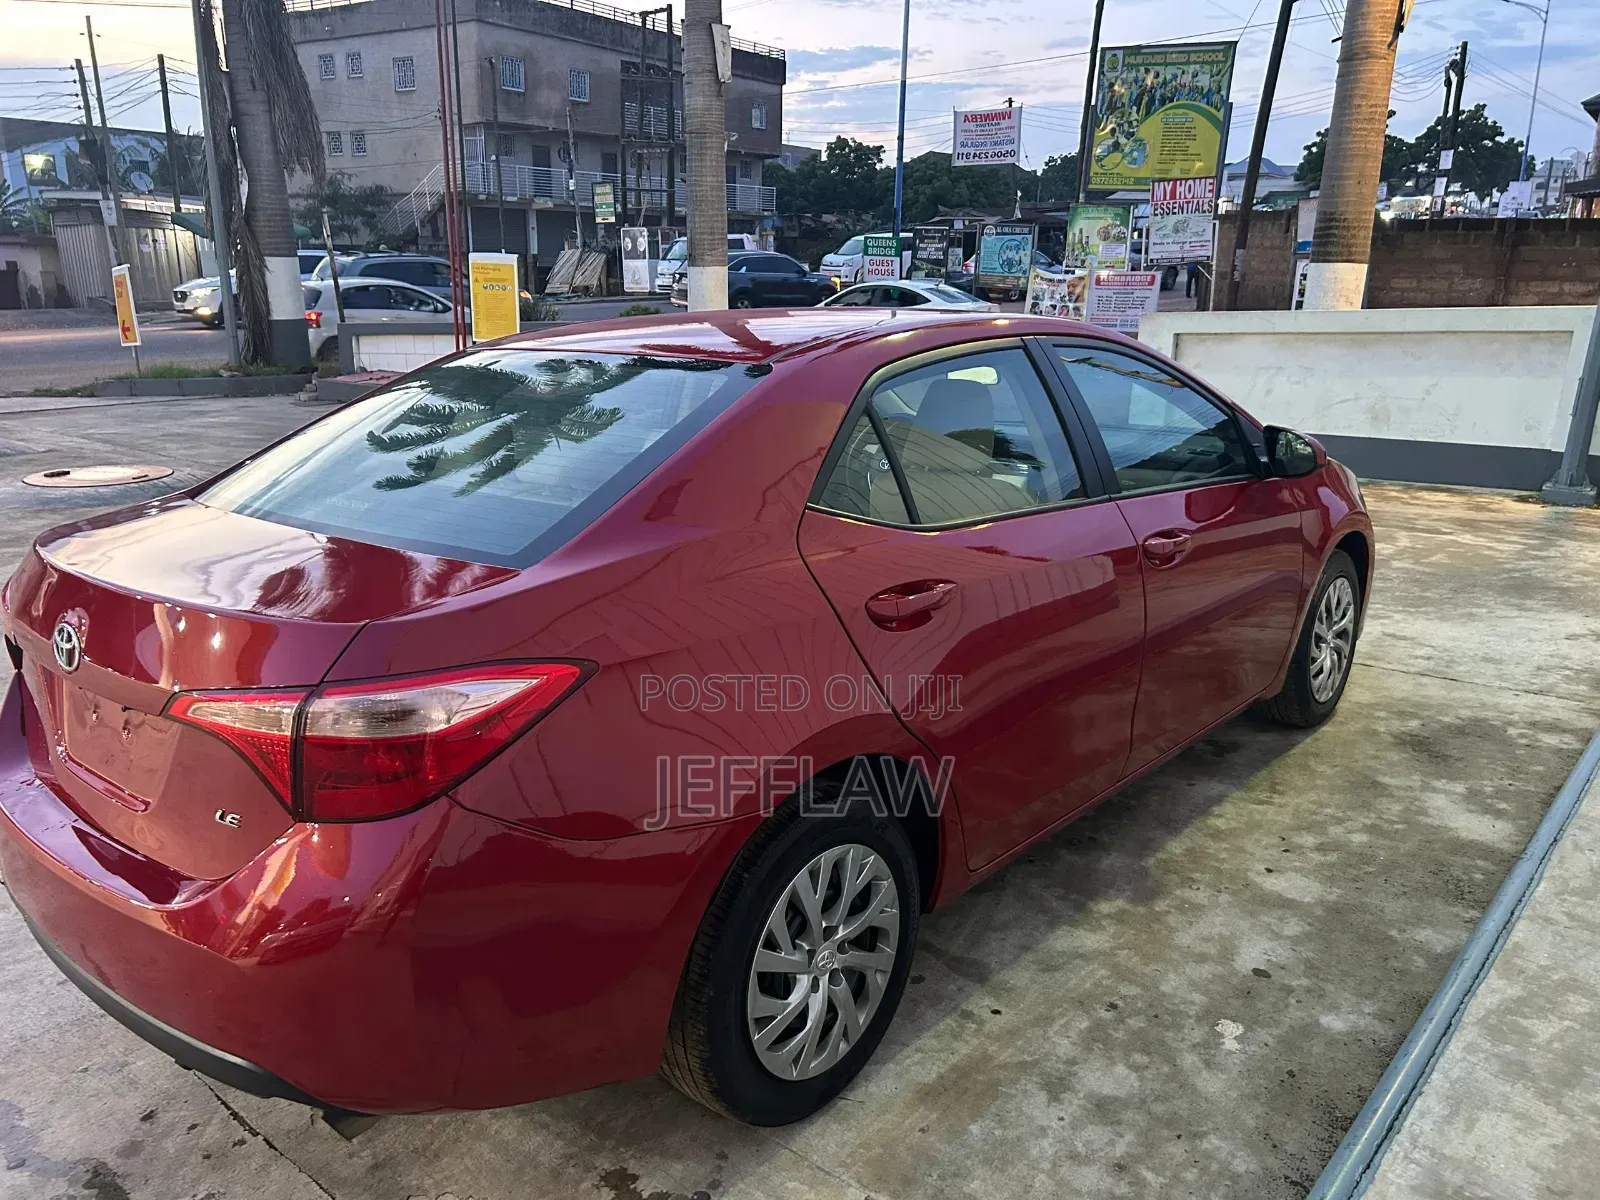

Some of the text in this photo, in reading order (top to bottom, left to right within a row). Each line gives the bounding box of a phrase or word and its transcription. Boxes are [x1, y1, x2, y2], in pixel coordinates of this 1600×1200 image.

[1189, 51, 1226, 62] SCHOOL
[1153, 178, 1214, 202] MY HOME
[1153, 199, 1214, 217] ESSENTIALS
[866, 238, 897, 248] QUEENS
[867, 247, 896, 256] BRIDGE
[868, 259, 895, 267] GUEST
[867, 268, 895, 277] HOUSE
[215, 808, 242, 828] LE
